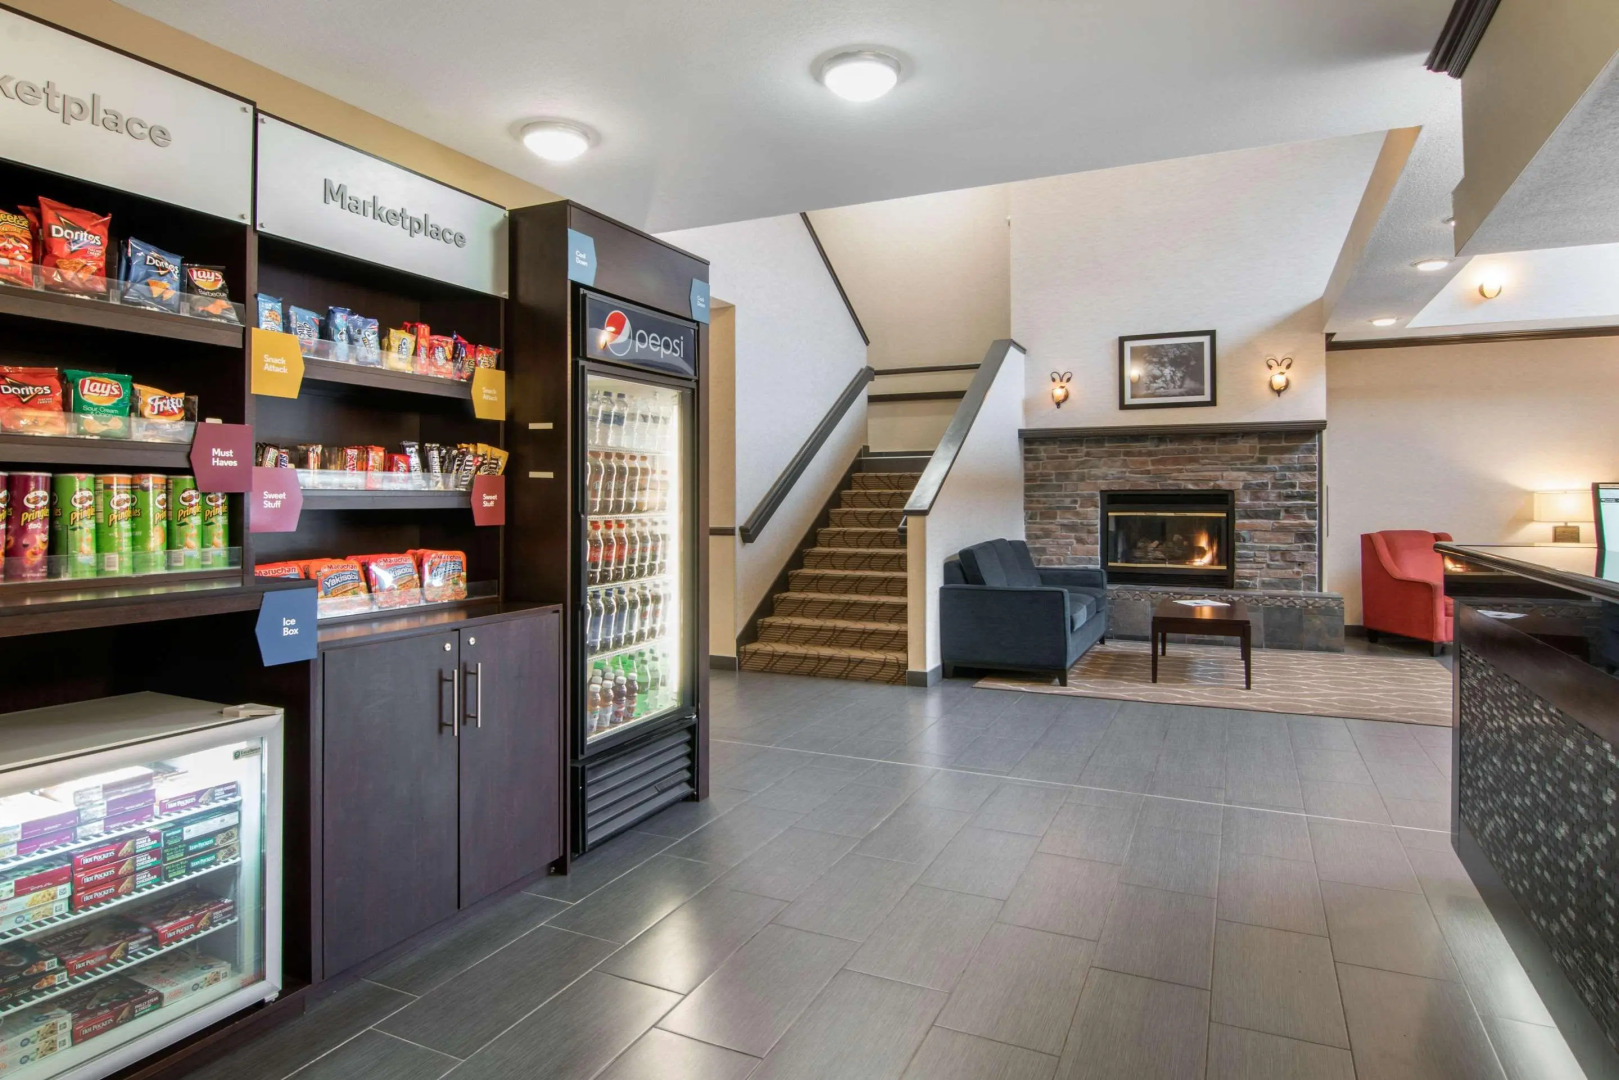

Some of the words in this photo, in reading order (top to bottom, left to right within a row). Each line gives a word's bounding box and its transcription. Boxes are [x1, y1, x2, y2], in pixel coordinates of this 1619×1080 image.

[323, 177, 467, 249] Marketplace
[51, 224, 102, 245] Doritos
[146, 255, 179, 275] Doritos
[635, 329, 684, 358] pepsi
[263, 354, 286, 365] Snack
[263, 363, 288, 374] Attack
[0, 384, 51, 396] Doritos
[212, 448, 233, 457] Must
[212, 457, 238, 466] Haves
[263, 491, 286, 500] Sweet
[263, 500, 281, 508] Stuff
[324, 573, 359, 588] Yakisoba
[282, 617, 296, 626] Ice
[282, 627, 299, 636] Box
[93, 851, 115, 862] POCKETS
[93, 869, 115, 880] POCKETS
[93, 887, 115, 899] POCKETS
[176, 923, 195, 935] POCKETS
[92, 1018, 114, 1031] POCKETS
